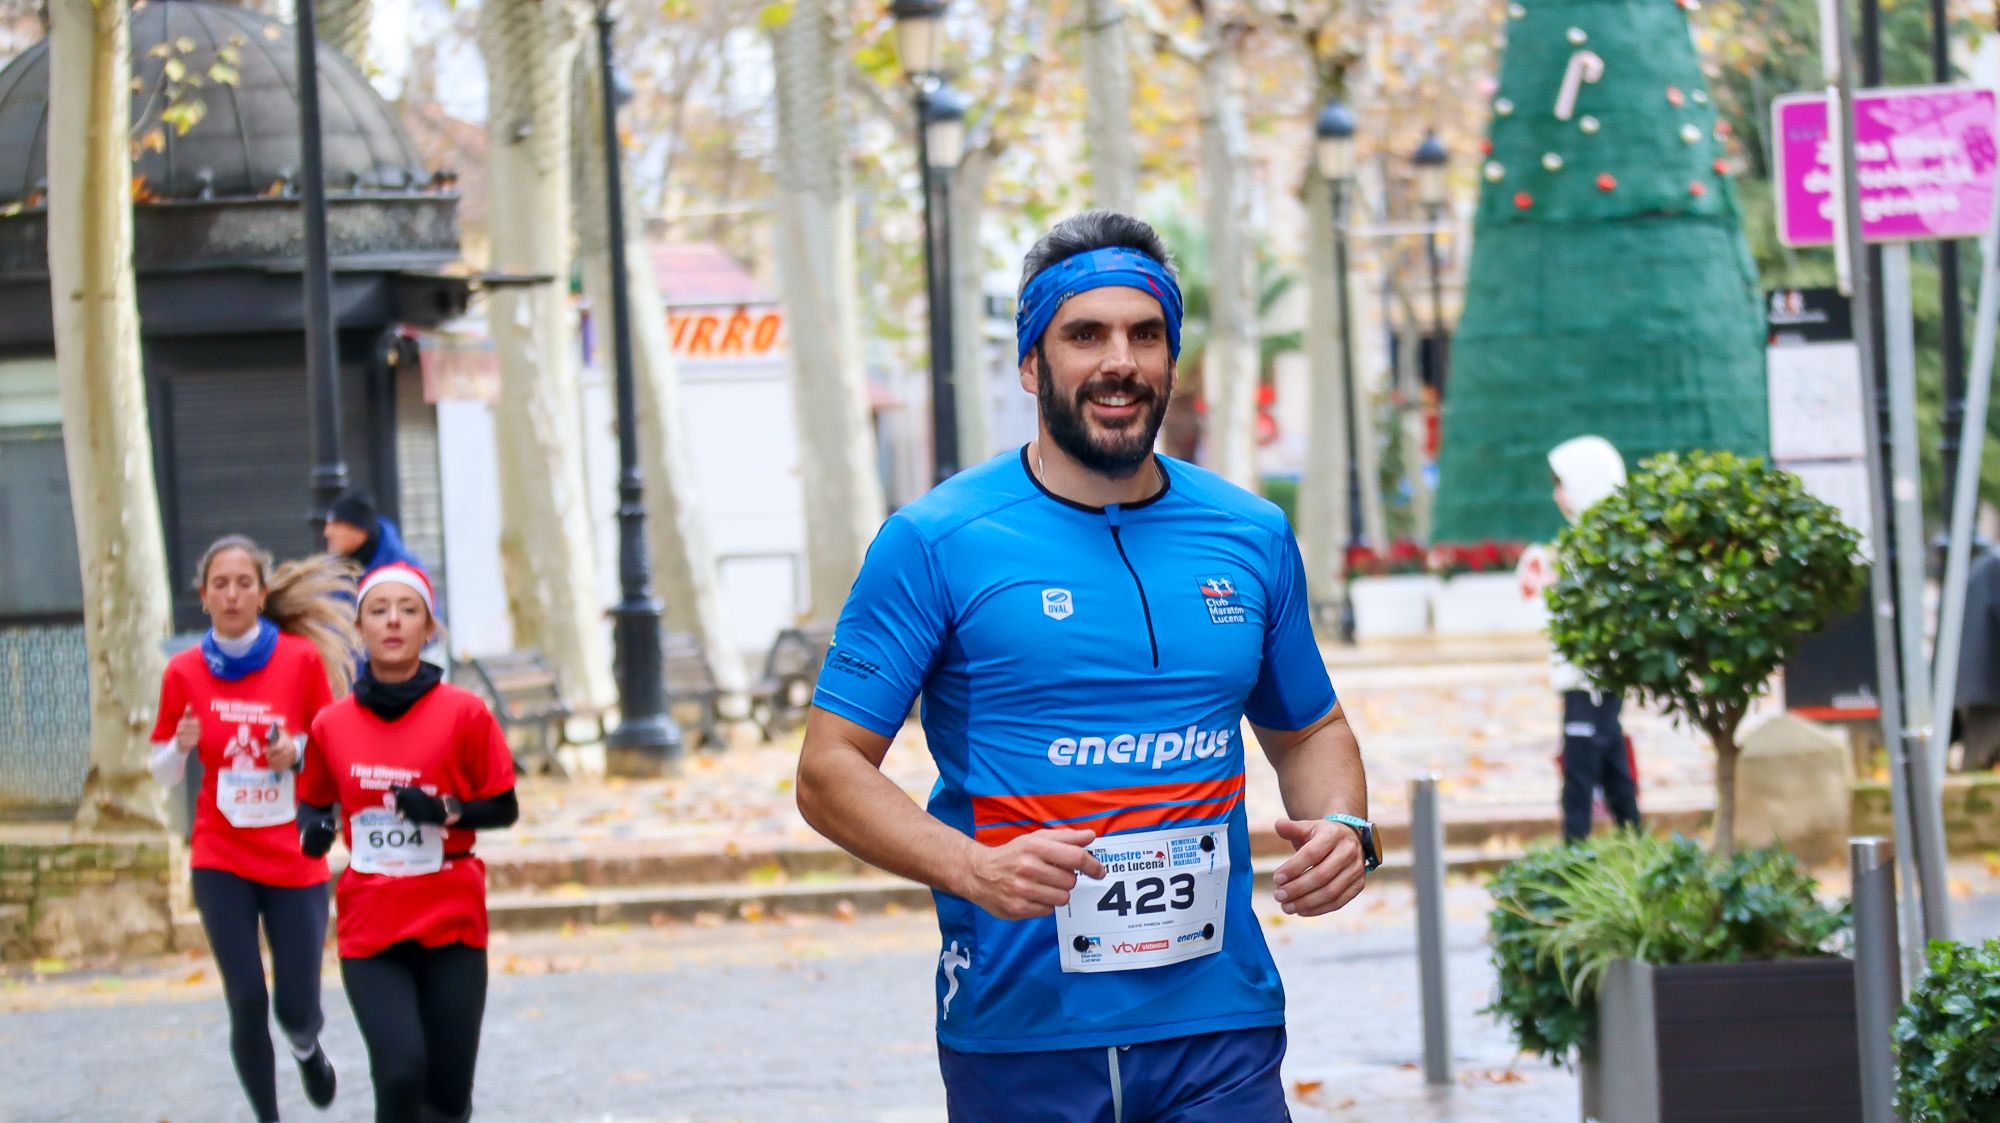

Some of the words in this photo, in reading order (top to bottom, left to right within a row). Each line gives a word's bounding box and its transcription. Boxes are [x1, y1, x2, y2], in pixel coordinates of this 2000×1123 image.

[1048, 604, 1069, 614] OVAL
[1206, 598, 1229, 607] Club
[1211, 615, 1245, 624] Lucena
[1048, 725, 1231, 769] enerplus
[234, 789, 279, 803] 230
[368, 830, 424, 848] 604
[1112, 863, 1126, 873] de
[1128, 860, 1164, 872] Lucena
[1097, 873, 1195, 917] 423
[1177, 929, 1205, 942] enerpl
